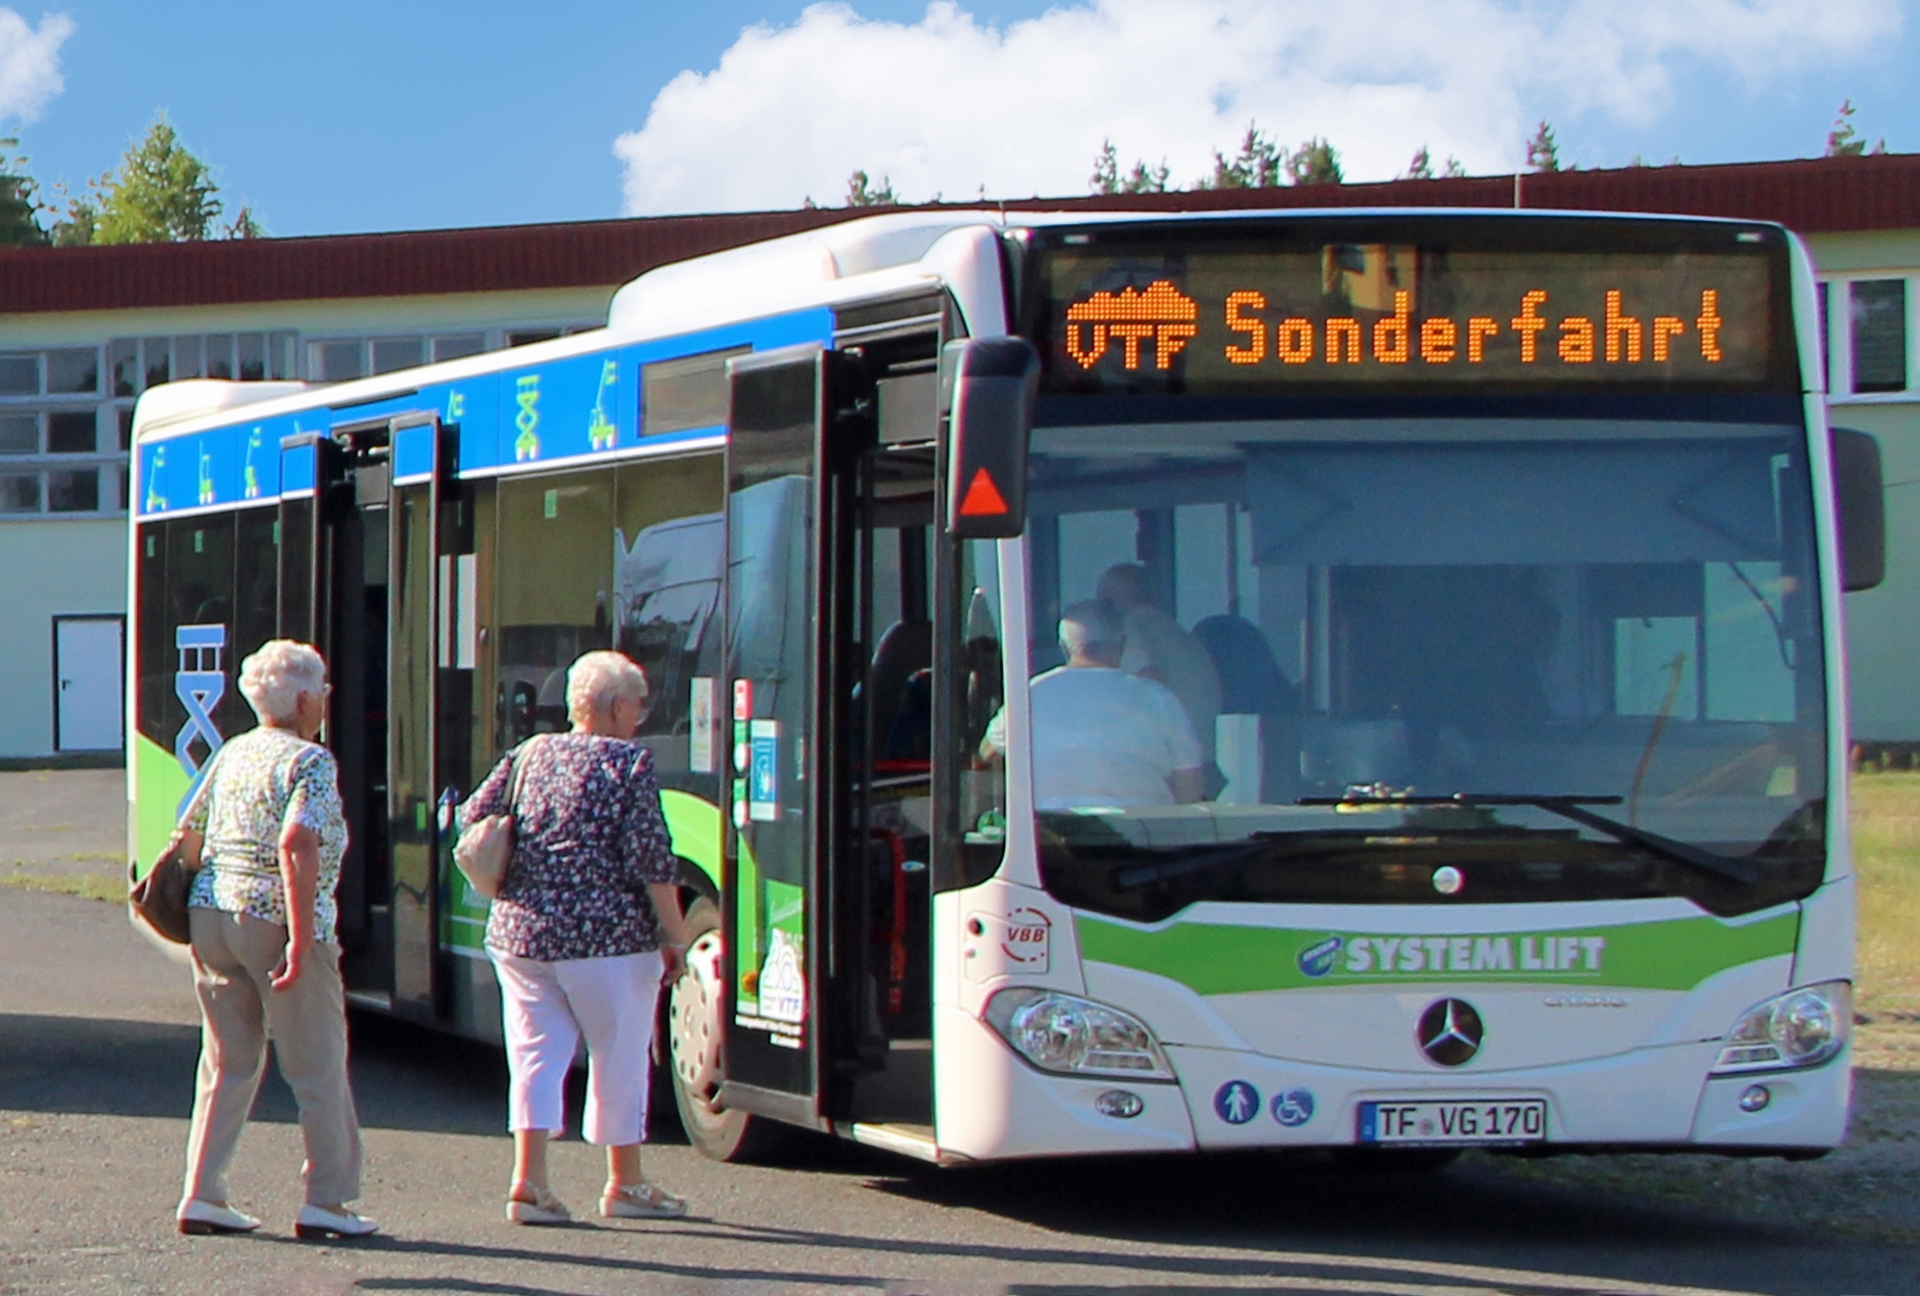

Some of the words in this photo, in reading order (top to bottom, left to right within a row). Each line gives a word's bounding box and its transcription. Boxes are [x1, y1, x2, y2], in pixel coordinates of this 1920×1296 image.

[1225, 290, 1723, 363] Sonderfahrt
[1067, 323, 1196, 369] VTF
[1008, 927, 1045, 942] VBB
[1345, 936, 1514, 971] SYSTEM
[1521, 936, 1605, 970] LIFT
[1380, 1107, 1416, 1135] TF
[1440, 1107, 1476, 1134] VG
[1485, 1107, 1540, 1134] 170
